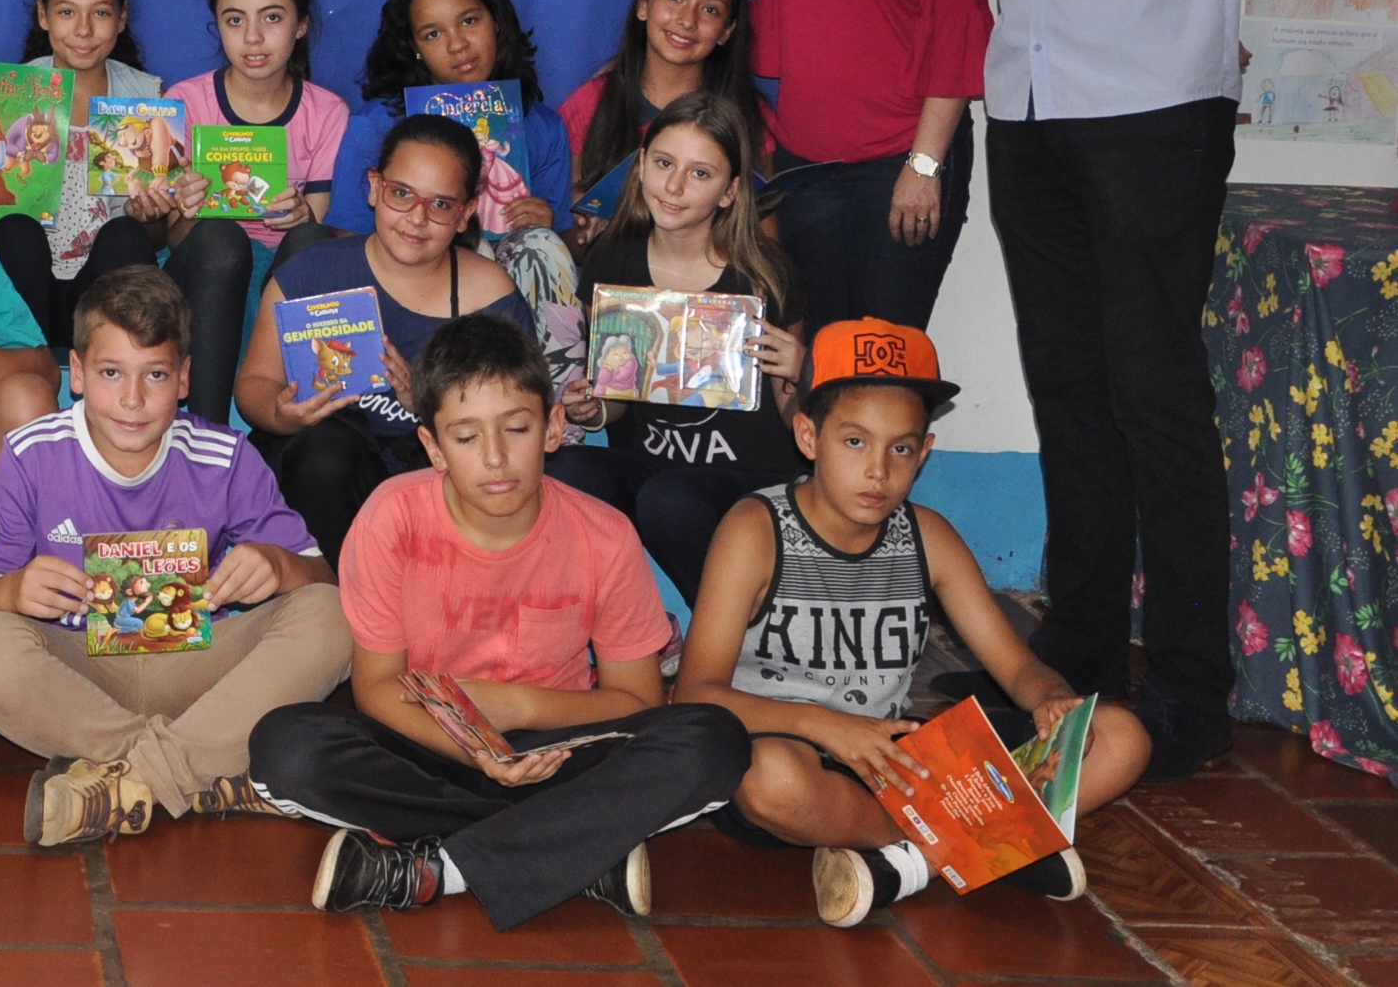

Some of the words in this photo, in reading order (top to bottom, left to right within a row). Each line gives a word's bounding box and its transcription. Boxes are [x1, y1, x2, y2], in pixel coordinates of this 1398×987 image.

[128, 106, 135, 115] E
[206, 152, 273, 162] CONSEGUE!
[284, 320, 375, 343] GENEROSIDADE
[643, 423, 738, 463] DIVA
[47, 533, 83, 545] adidas
[97, 541, 162, 558] DANIEL
[167, 542, 175, 553] E
[179, 541, 198, 553] OS
[142, 557, 200, 575] LEÕES
[755, 602, 929, 670] KINGS
